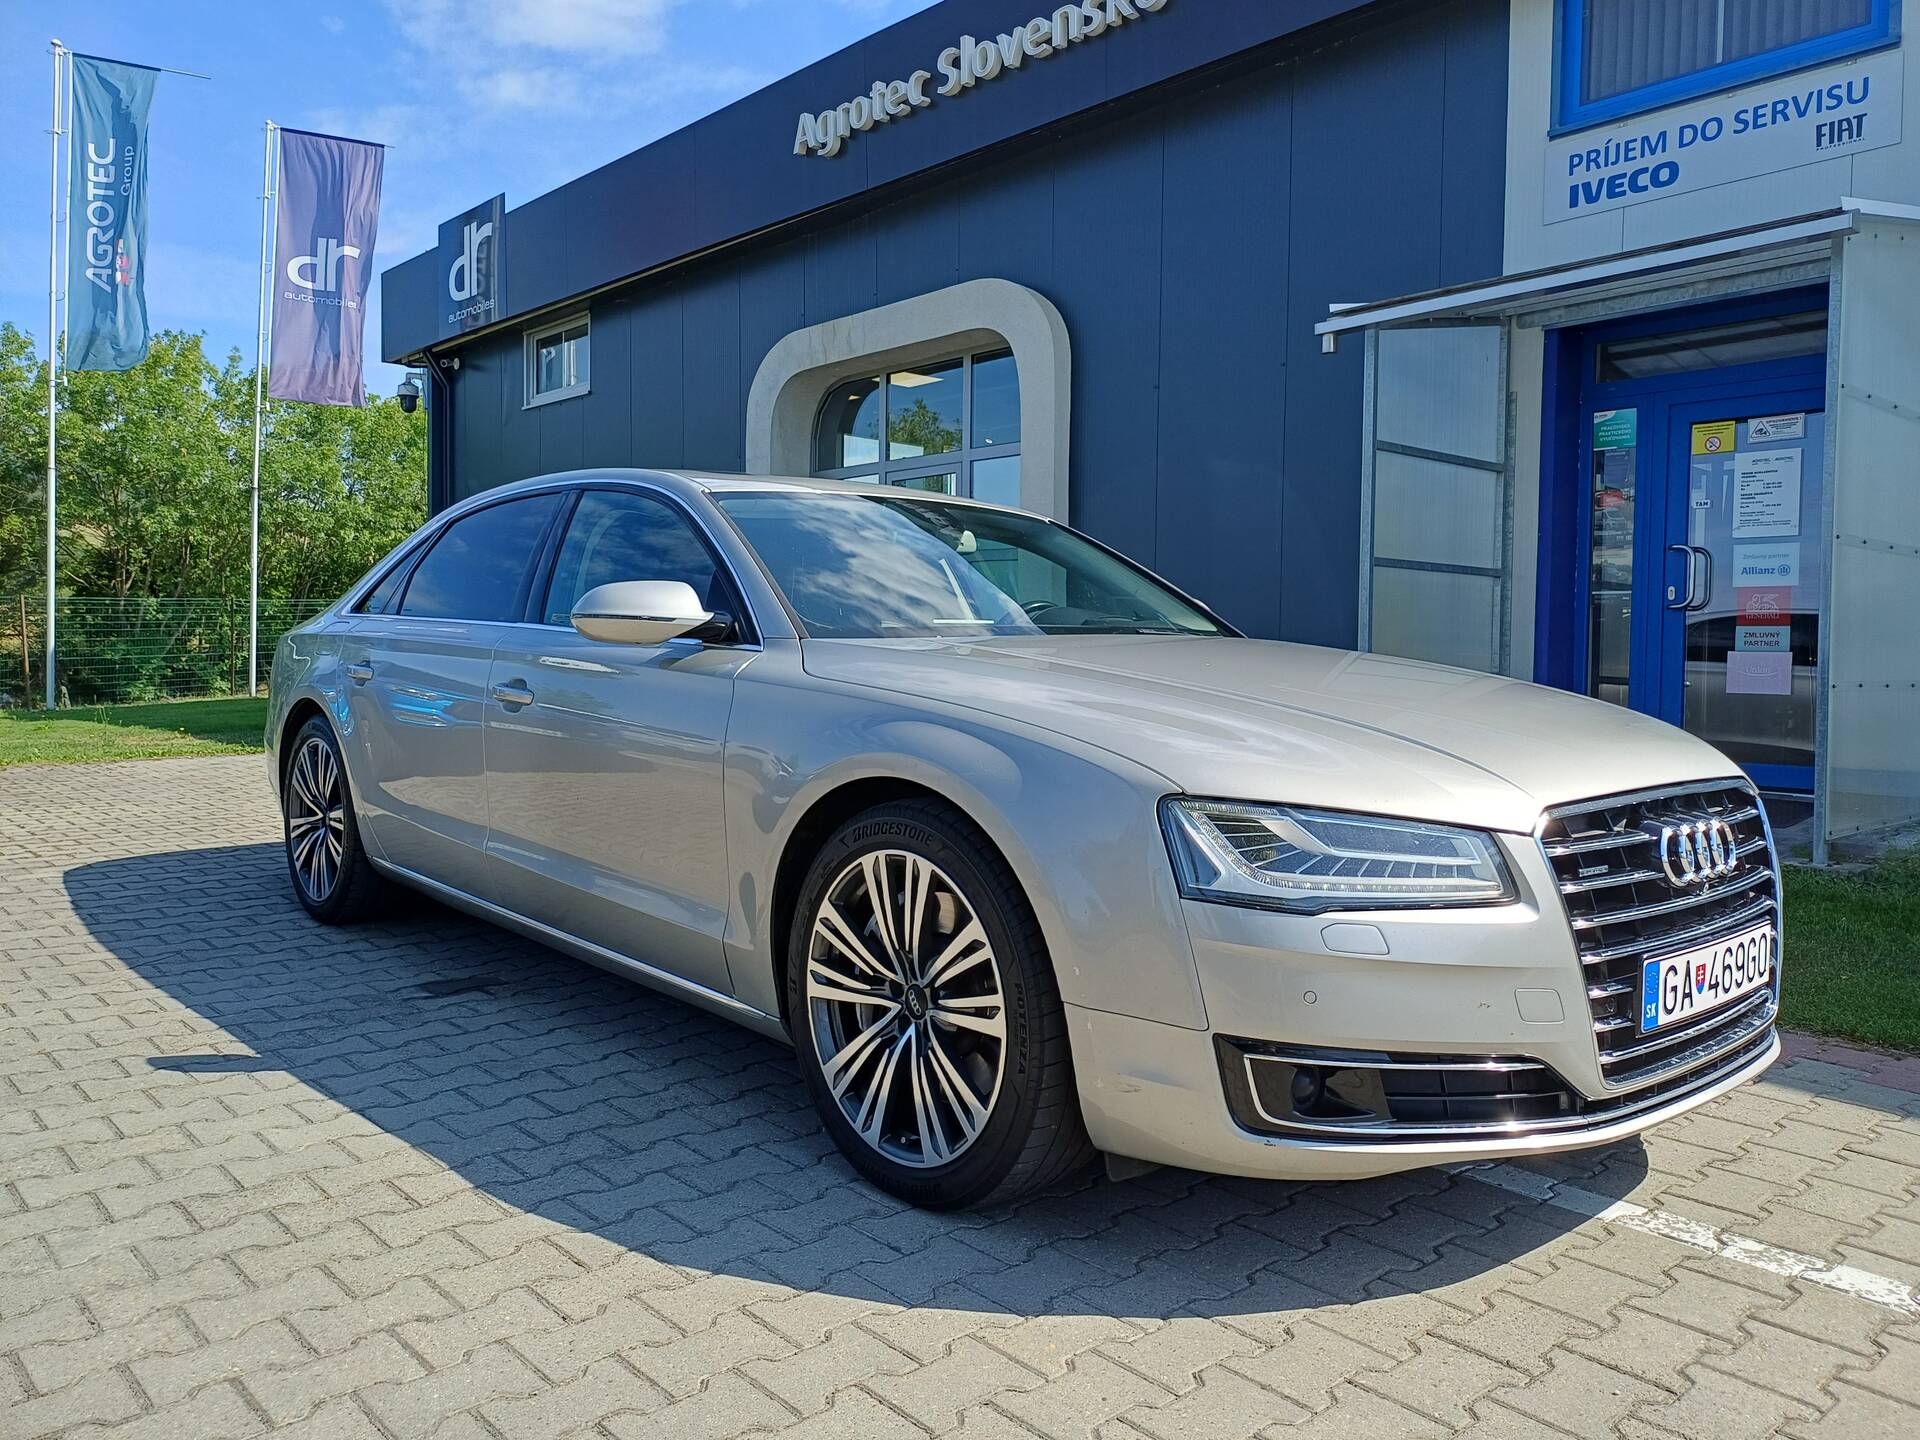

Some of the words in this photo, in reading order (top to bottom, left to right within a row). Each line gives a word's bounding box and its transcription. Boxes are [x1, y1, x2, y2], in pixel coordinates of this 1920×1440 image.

[793, 70, 933, 157] Agrotec
[1569, 130, 1667, 176] PRÍJEM
[1678, 116, 1723, 149] DO
[1733, 76, 1870, 135] SERVISU
[1816, 113, 1867, 147] FIAT
[121, 145, 135, 196] Group
[1569, 160, 1680, 208] IVECO
[85, 138, 117, 293] AGROTEC
[286, 237, 361, 292] dr
[449, 221, 493, 301] dr
[448, 298, 495, 324] automobiles
[1741, 565, 1776, 575] Allianz
[1743, 630, 1781, 639] ZMLUVNÝ
[852, 822, 934, 847] BRIDGESTONE
[1663, 959, 1694, 1016] GA
[1707, 932, 1768, 1000] 469GO
[1014, 981, 1029, 1076] POTENZA
[1645, 1002, 1657, 1019] SK
